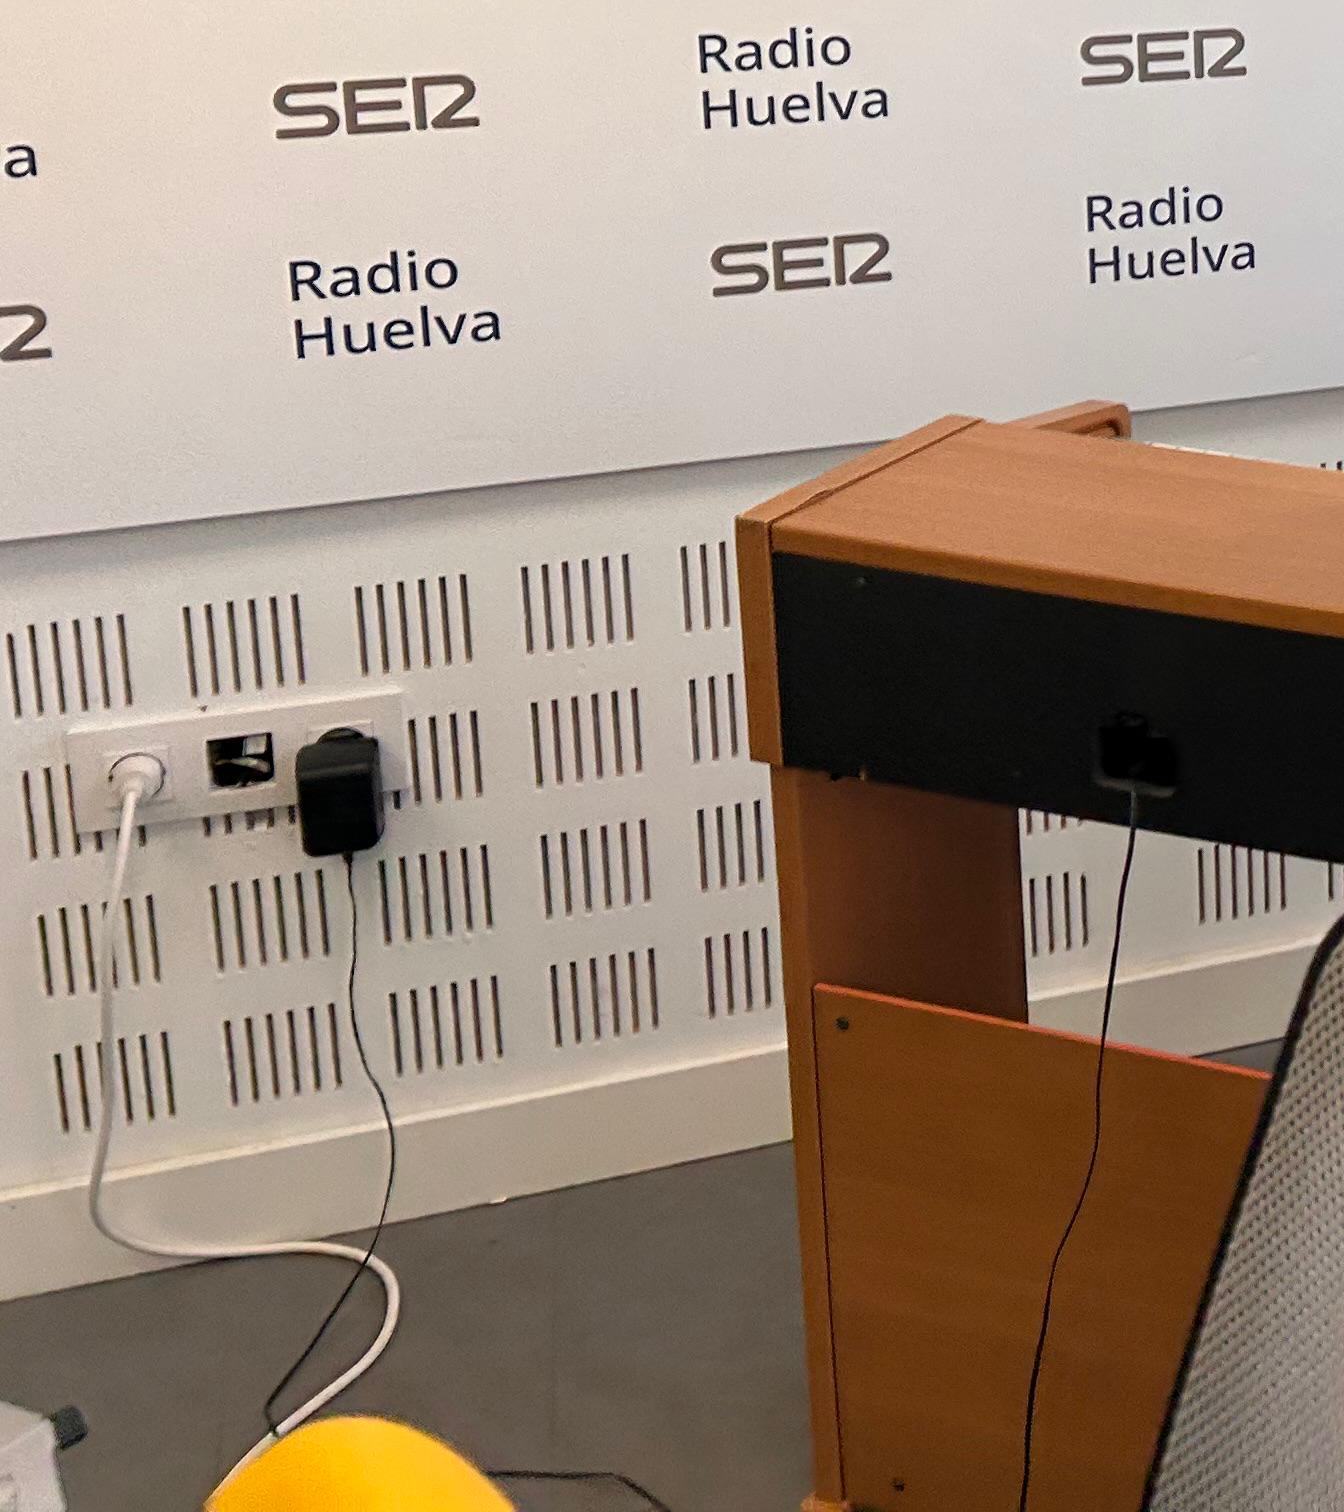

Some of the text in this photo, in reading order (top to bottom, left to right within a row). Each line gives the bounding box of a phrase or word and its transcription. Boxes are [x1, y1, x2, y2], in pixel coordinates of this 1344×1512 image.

[696, 25, 853, 76] Radio
[1078, 26, 1249, 88] SER
[271, 72, 482, 142] SER
[700, 79, 890, 131] Huelva
[1084, 184, 1225, 234] Radio
[287, 247, 460, 304] Radio
[708, 230, 895, 299] SER
[1087, 234, 1257, 286] Huelva
[292, 303, 503, 361] Huelva
